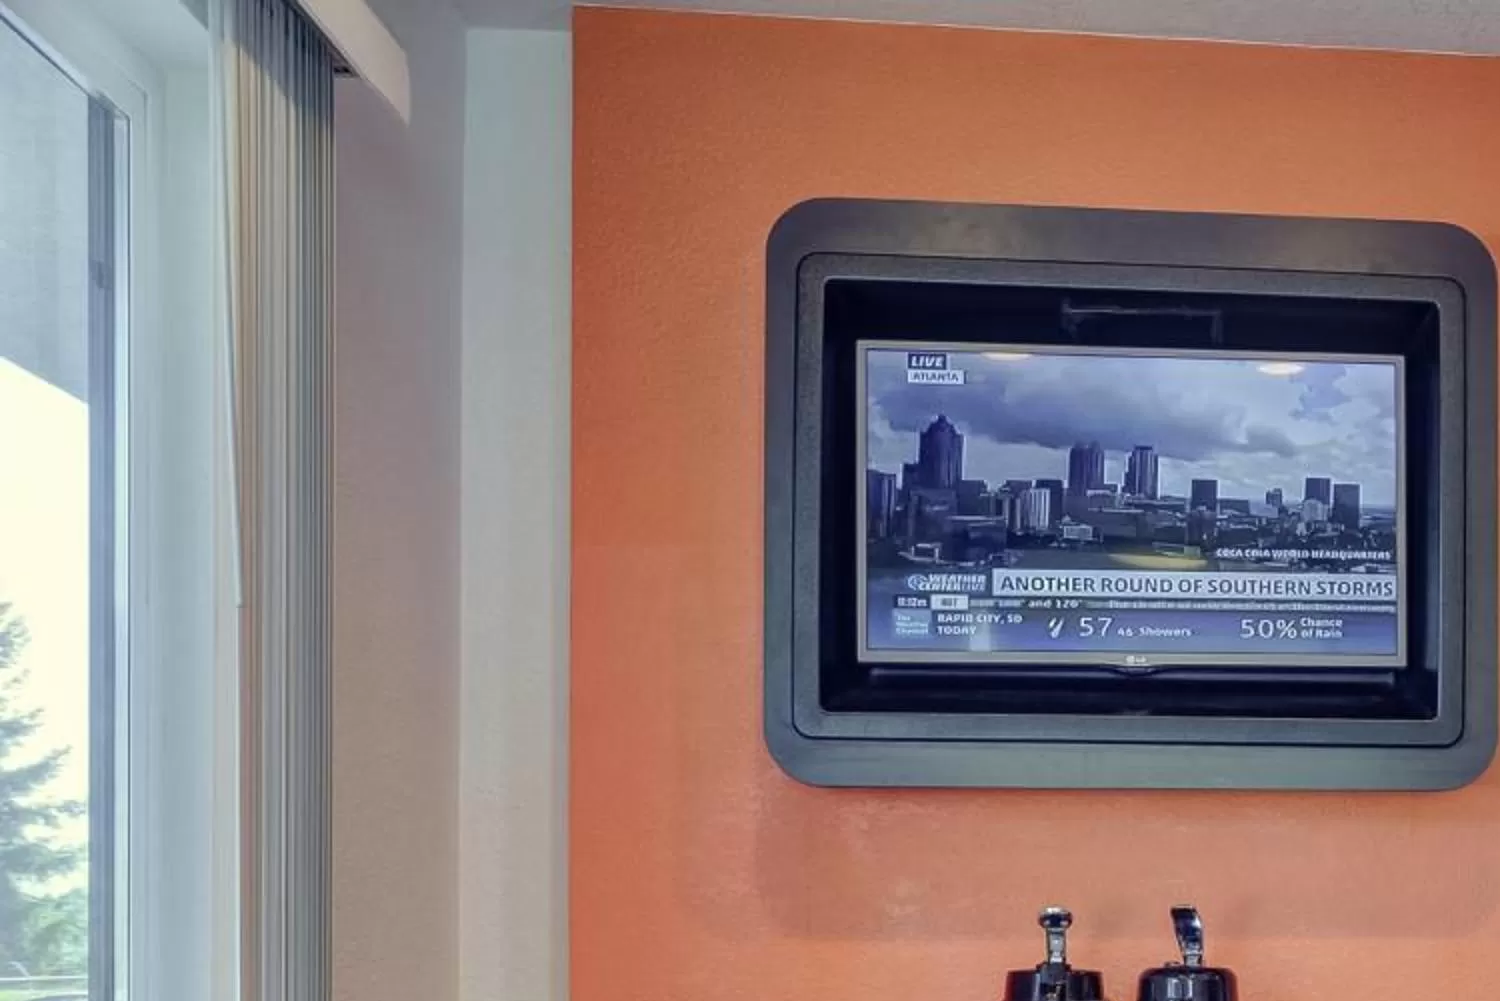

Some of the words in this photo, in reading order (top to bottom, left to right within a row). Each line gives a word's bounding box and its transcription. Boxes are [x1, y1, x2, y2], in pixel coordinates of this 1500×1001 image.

[911, 355, 944, 367] LIVE
[912, 372, 959, 382] ATLANTA
[1001, 576, 1096, 592] ANOTHER
[1101, 577, 1173, 593] ROUND
[1178, 578, 1203, 593] OF
[1207, 579, 1311, 595] SOUTHERN
[1316, 581, 1393, 596] STORMS
[937, 613, 973, 623] RAPID
[1300, 617, 1343, 627] Chance
[936, 625, 977, 635] TODAY
[1079, 617, 1112, 637] 57
[1139, 625, 1192, 637] Showers
[1240, 619, 1297, 640] 50%
[1301, 628, 1314, 638] of
[1316, 628, 1343, 639] Rain
